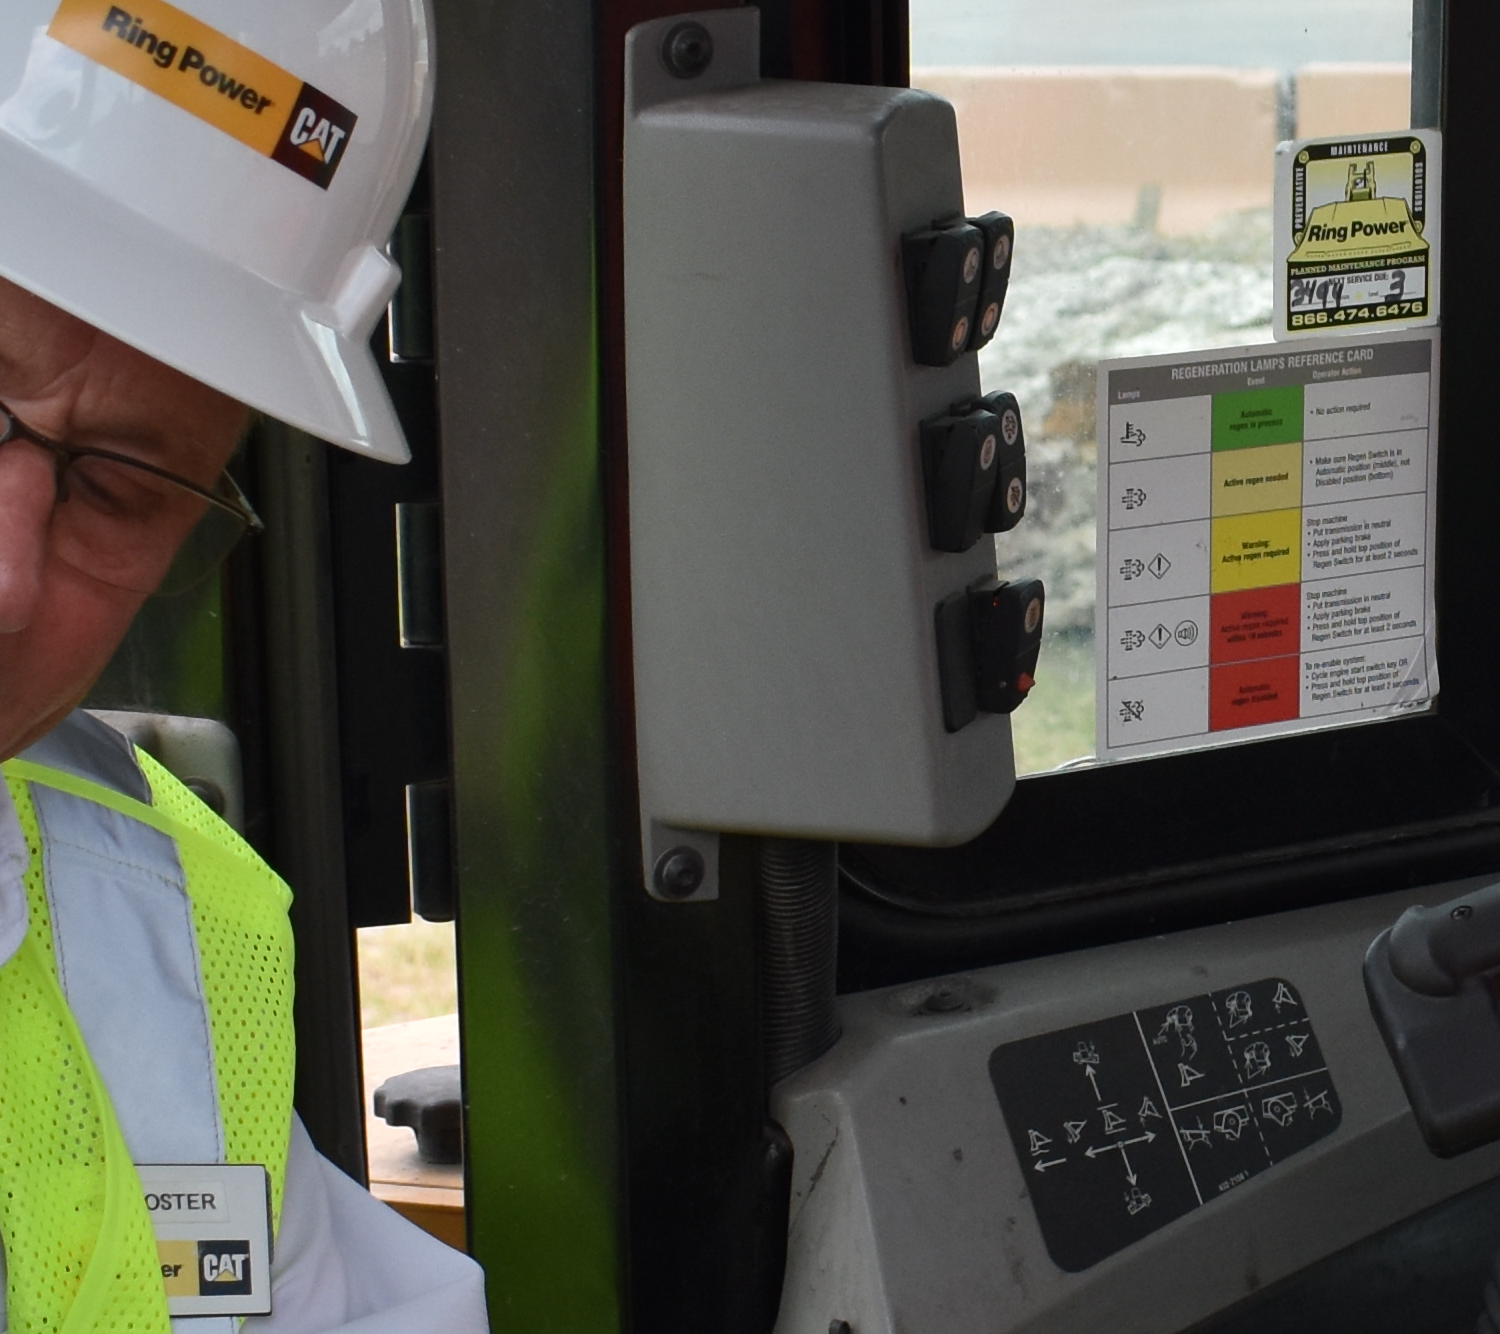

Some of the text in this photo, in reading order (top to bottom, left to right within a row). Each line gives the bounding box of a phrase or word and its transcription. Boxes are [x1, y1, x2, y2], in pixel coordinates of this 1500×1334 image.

[102, 5, 345, 164] Ring Power CAT
[1331, 141, 1388, 156] MAINTENANCE
[1415, 162, 1423, 212] SOLUTIONS
[1295, 167, 1304, 230] PREVENTATIVE
[1307, 220, 1406, 242] Ring Power
[1290, 255, 1425, 276] PLANNED MAINTENANCE PROGRAM
[1347, 274, 1373, 284] SERVICE
[1292, 301, 1423, 326] 866.474.6476
[1171, 348, 1374, 380] REGENERATION LAMPS REFERENCE CARD
[1312, 367, 1362, 379] Operator Action
[1247, 377, 1265, 386] Event
[1117, 390, 1141, 400] Lamps
[1326, 406, 1345, 414] action
[1346, 403, 1371, 413] required
[1348, 453, 1366, 462] Regen
[161, 1253, 247, 1282] er CAT
